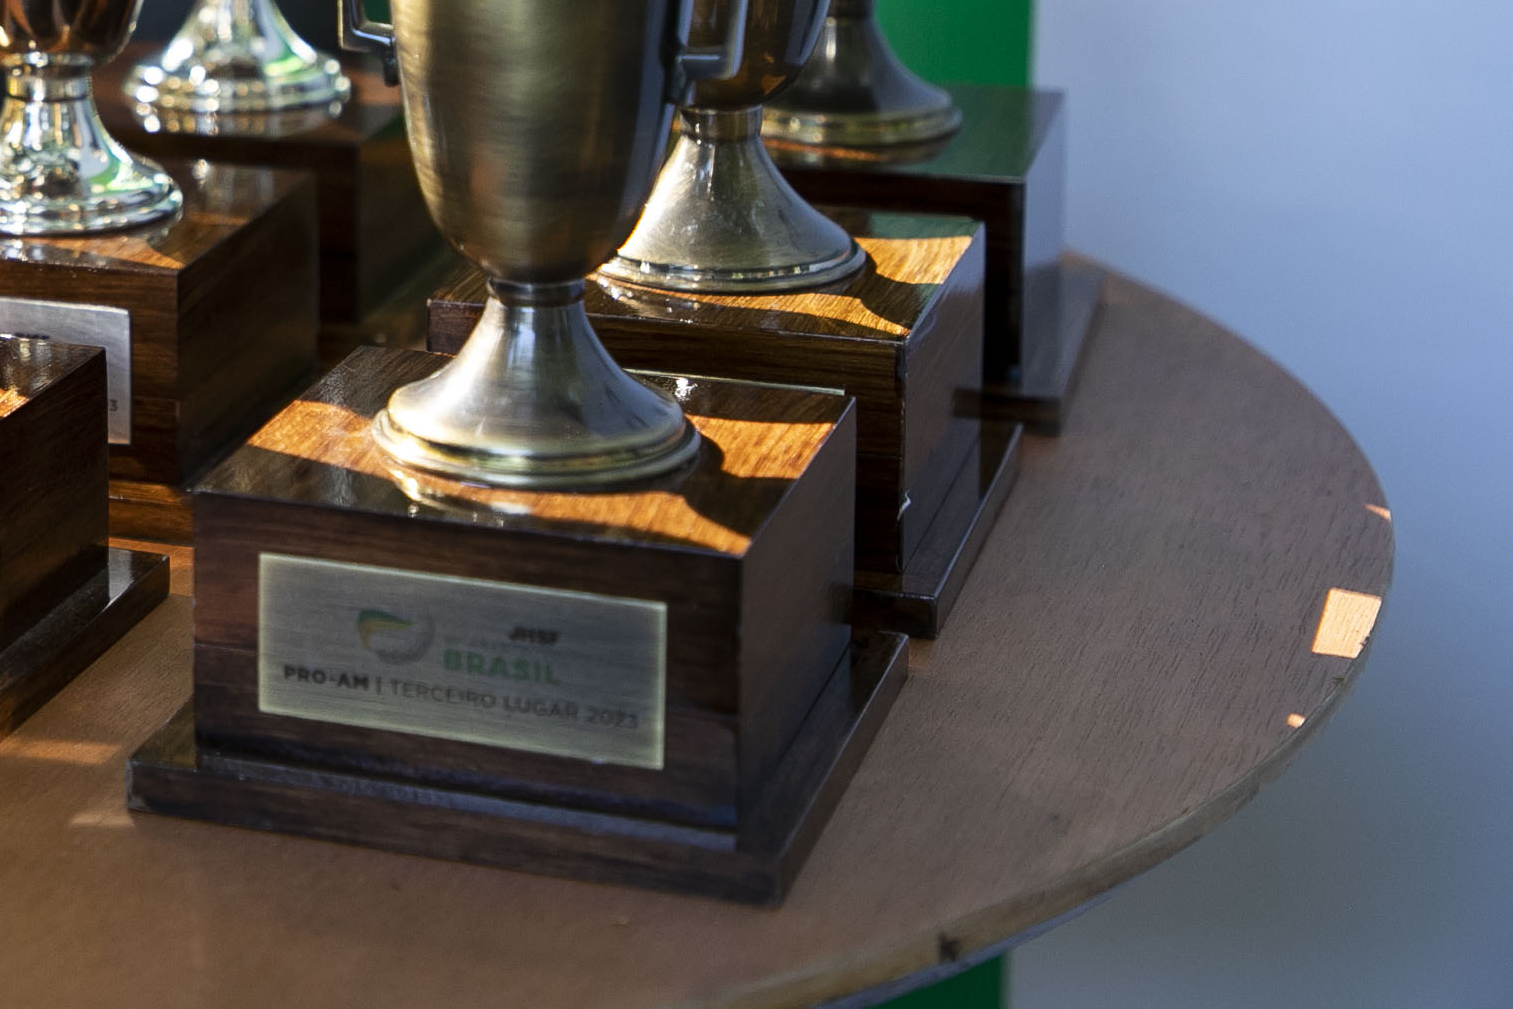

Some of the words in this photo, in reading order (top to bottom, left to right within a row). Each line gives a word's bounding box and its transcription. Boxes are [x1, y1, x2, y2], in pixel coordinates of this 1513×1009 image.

[443, 648, 562, 686] BRASIL
[284, 664, 370, 691] PRO-AM
[390, 678, 497, 709] TERCEIRO
[501, 694, 579, 720] LUGAR
